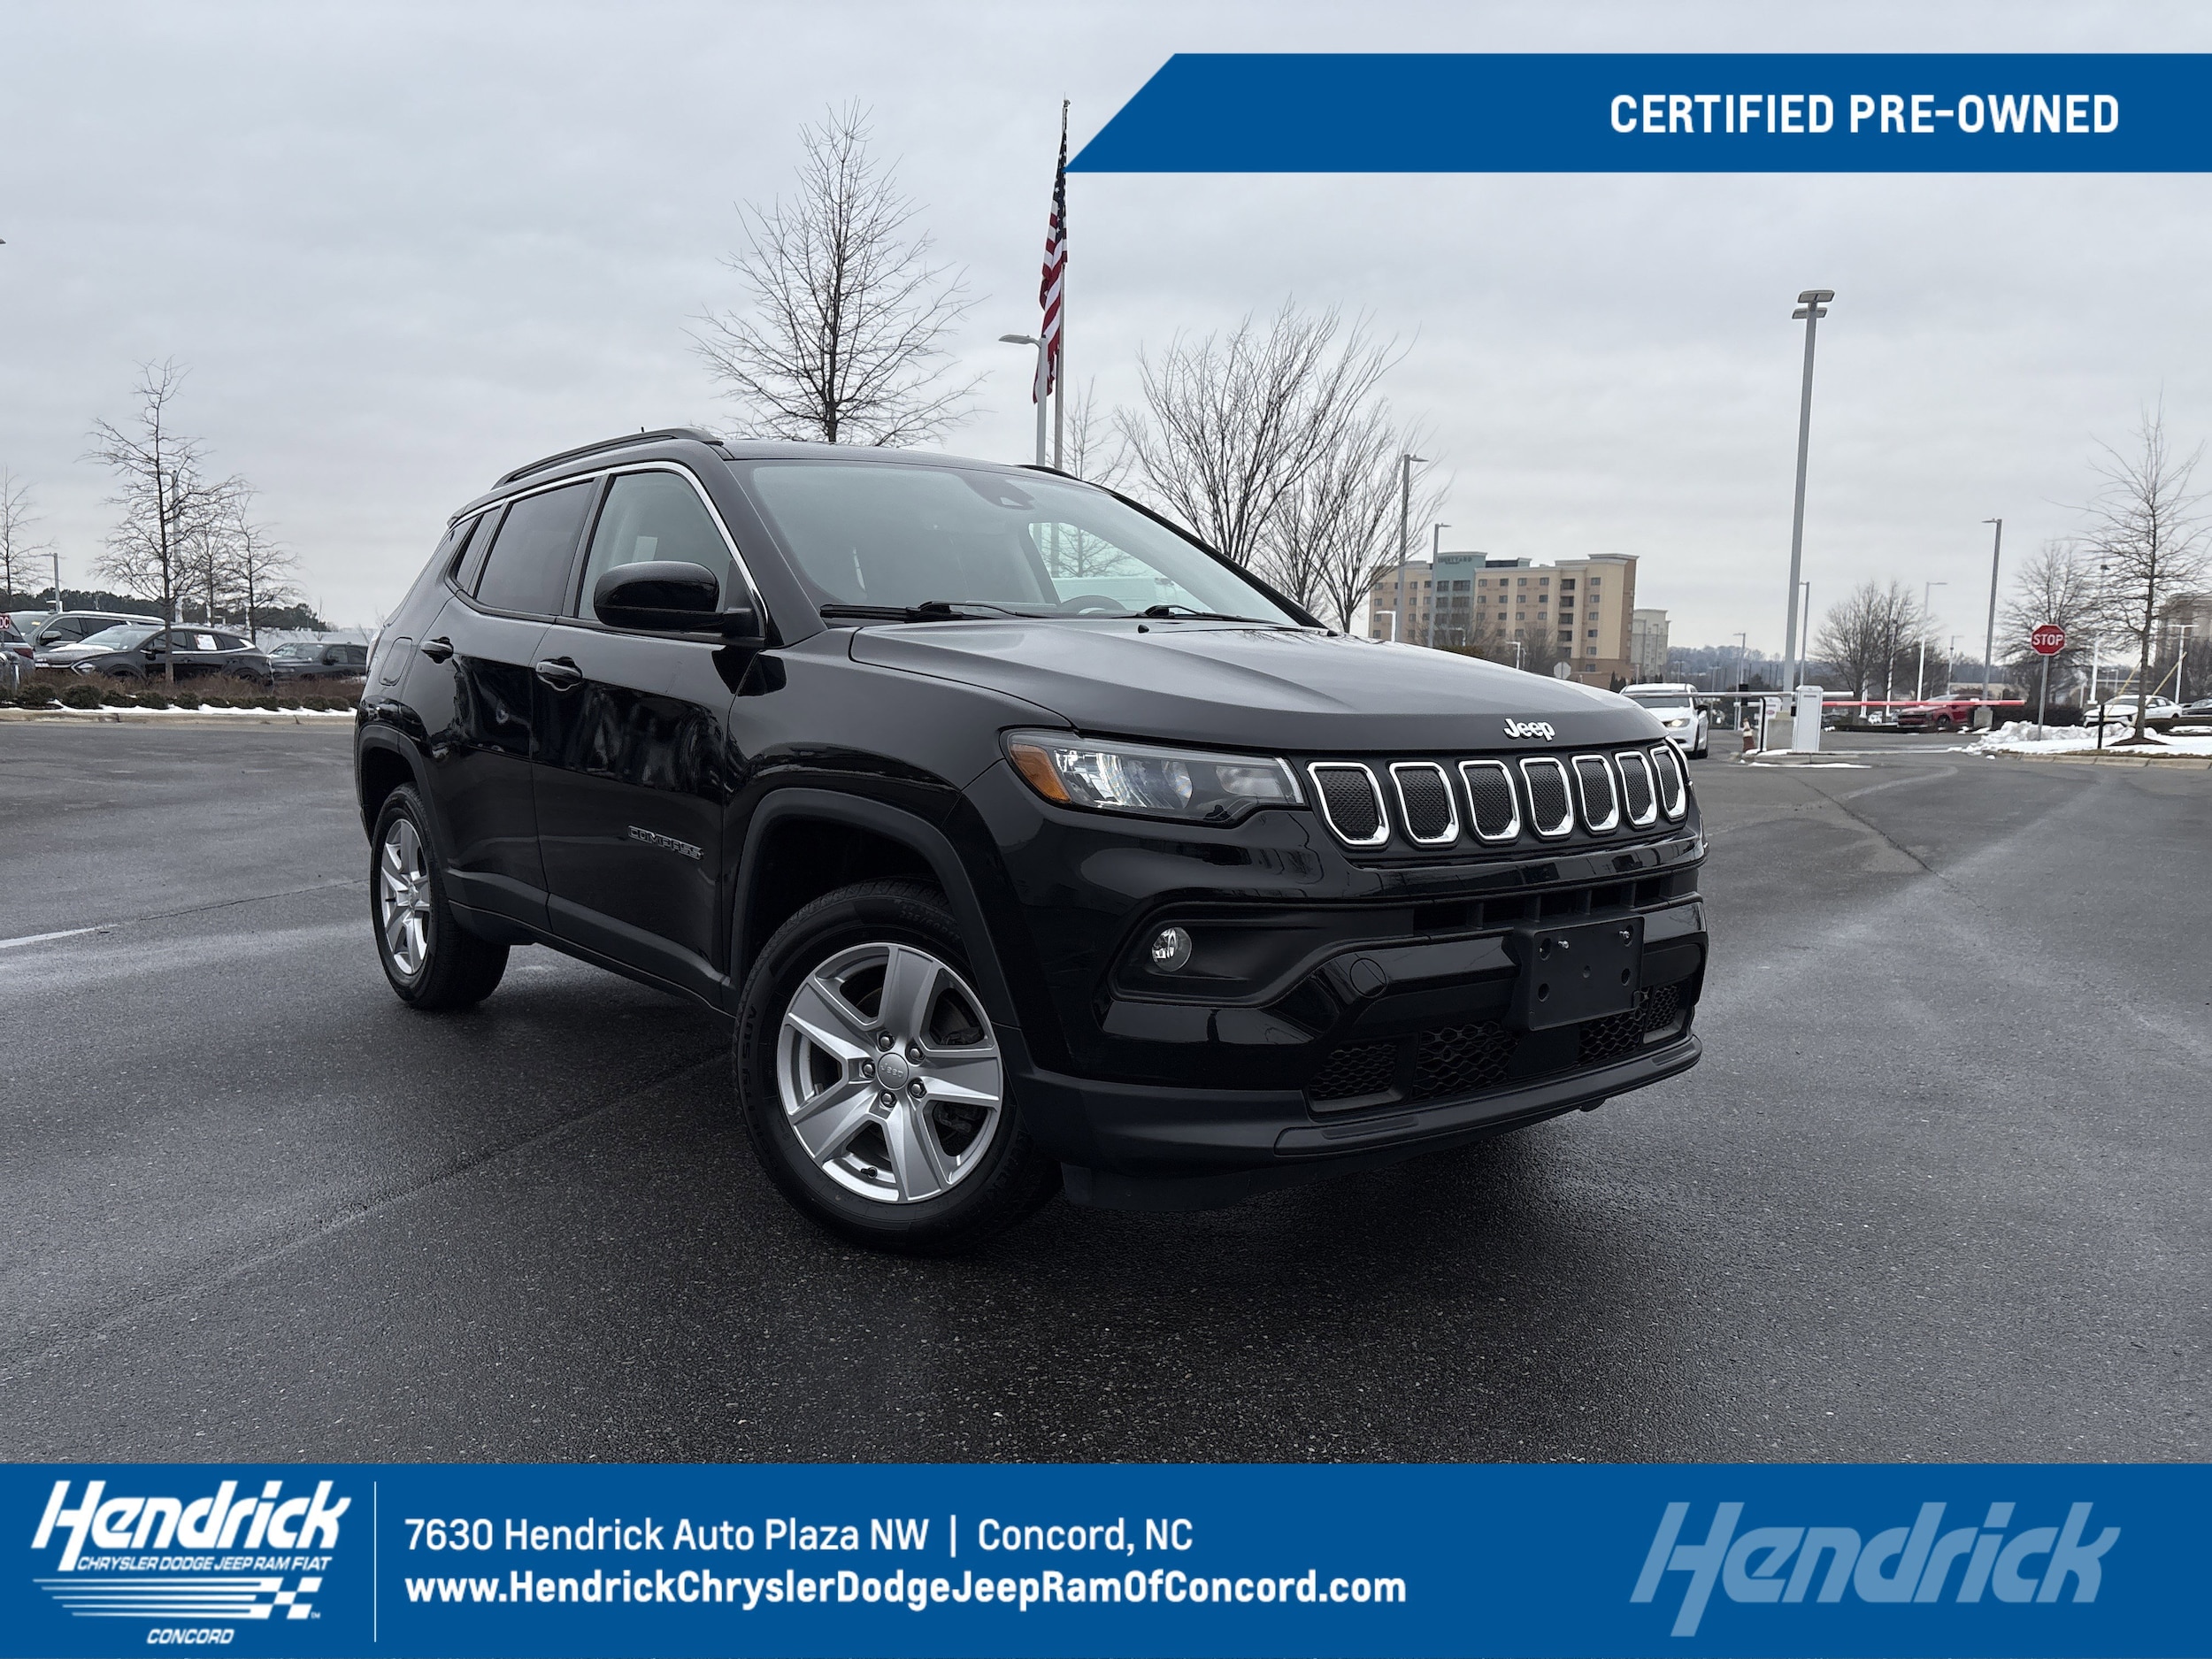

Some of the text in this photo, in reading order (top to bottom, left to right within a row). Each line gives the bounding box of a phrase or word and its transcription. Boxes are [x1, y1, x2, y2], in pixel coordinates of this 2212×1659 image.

[2032, 634, 2063, 645] STOP
[1503, 718, 1555, 741] Jeep
[627, 825, 704, 861] COMPASS
[742, 1005, 757, 1059] SUV
[880, 1063, 904, 1078] Jeep
